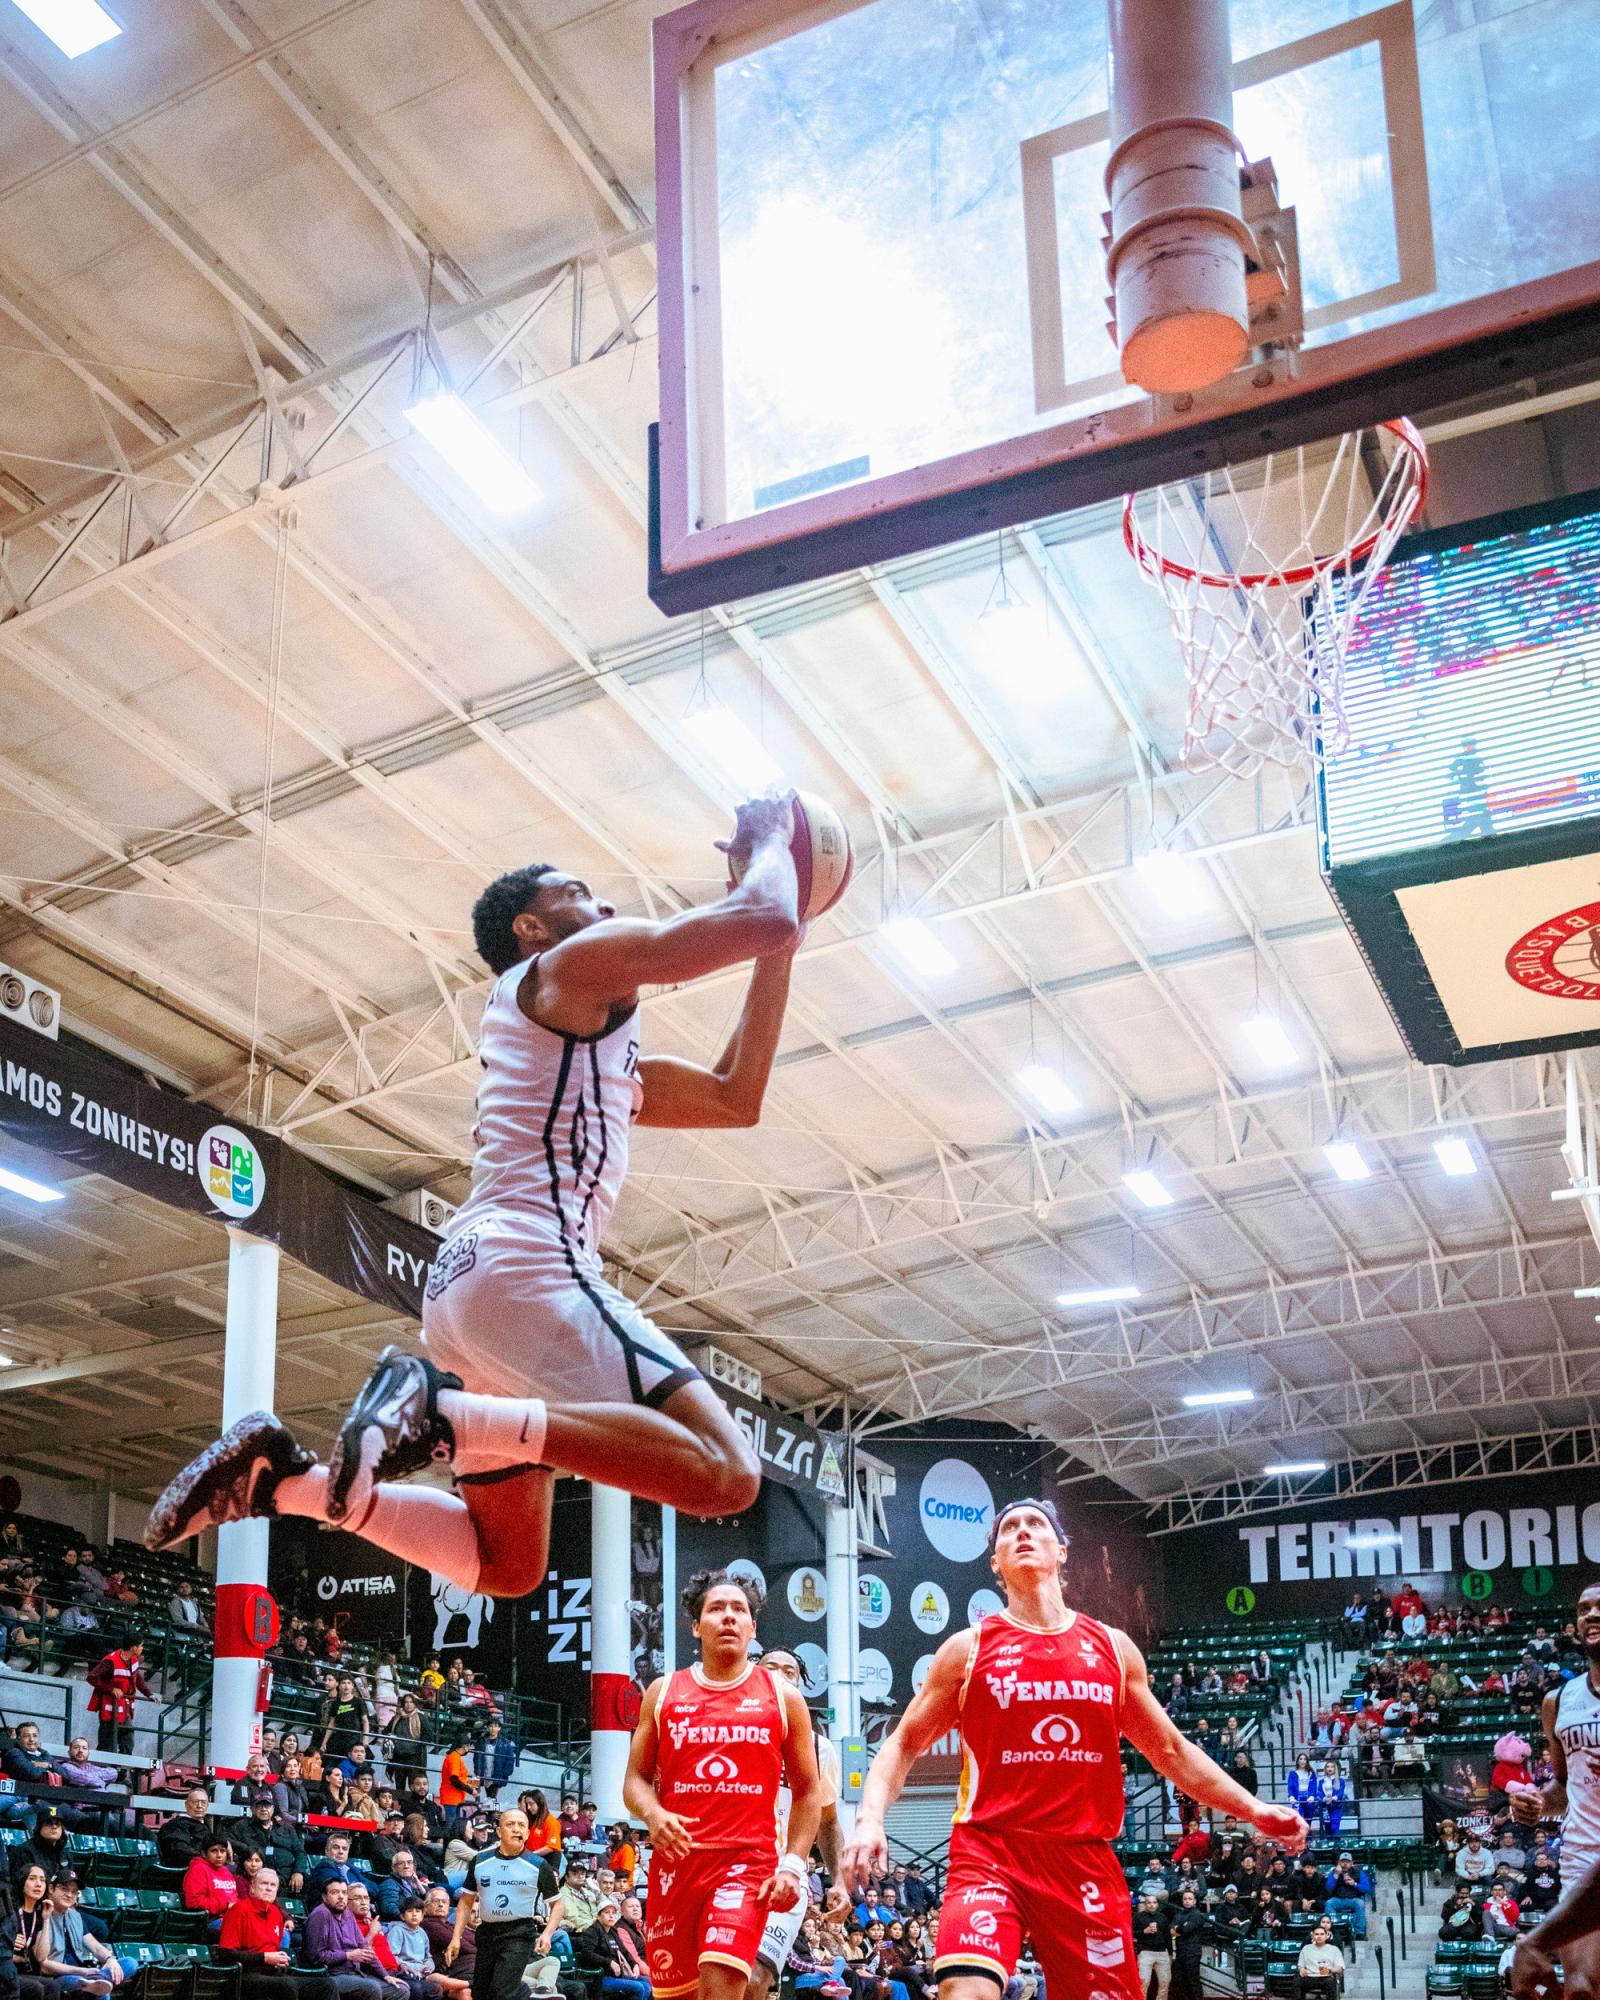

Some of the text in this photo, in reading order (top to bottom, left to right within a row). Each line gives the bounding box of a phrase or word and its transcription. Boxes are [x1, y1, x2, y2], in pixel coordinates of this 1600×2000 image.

[70, 1091, 194, 1175] ZONKEYS!
[924, 1497, 989, 1524] Comex
[340, 1575, 396, 1594] ATISA
[1234, 1589, 1248, 1612] A
[254, 1597, 272, 1643] B
[858, 1666, 888, 1681] EPIC
[986, 1670, 1114, 1709] VENADOS
[667, 1717, 771, 1750] VENADOS
[1001, 1747, 1103, 1764] Banco Azteca
[674, 1781, 763, 1794] Banco Azteca
[1079, 1881, 1105, 1913] 2
[959, 1933, 1001, 1955] MEGA
[651, 1969, 683, 1981] MEGA
